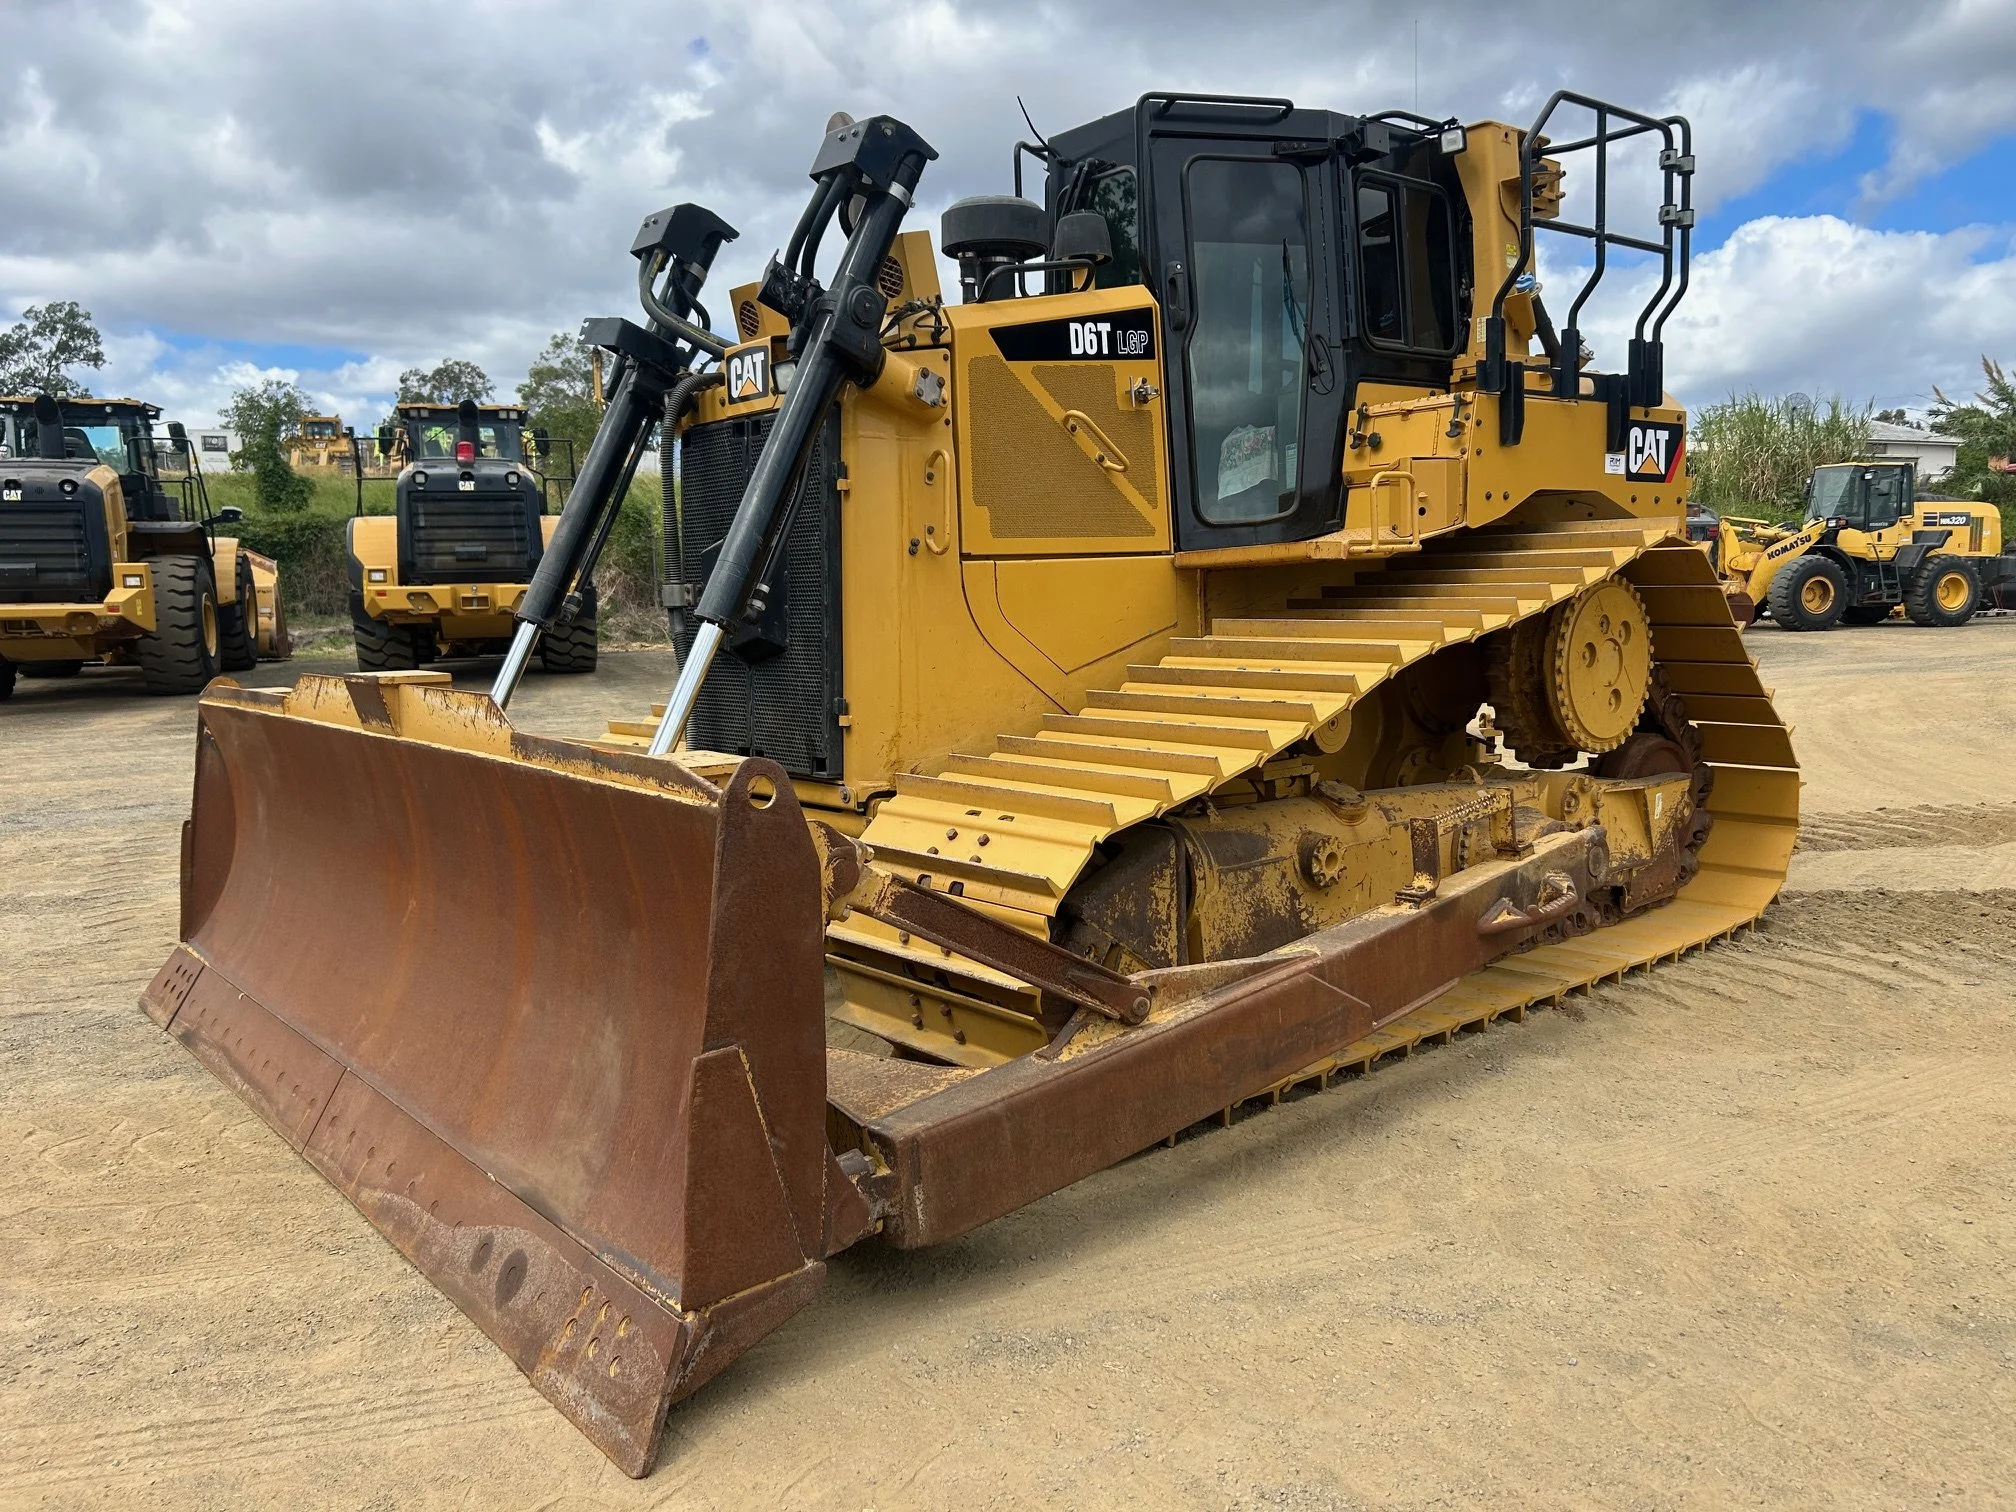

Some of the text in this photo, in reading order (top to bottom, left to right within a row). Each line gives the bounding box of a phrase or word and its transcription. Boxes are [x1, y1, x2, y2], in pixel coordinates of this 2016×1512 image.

[1069, 322, 1148, 355] D6T LGP
[730, 351, 765, 398] CAT
[1629, 426, 1669, 475] CAT
[3, 489, 22, 500] CAT
[458, 480, 475, 490] CAT
[1940, 516, 1966, 525] WA320
[1767, 534, 1811, 560] KOMATSU
